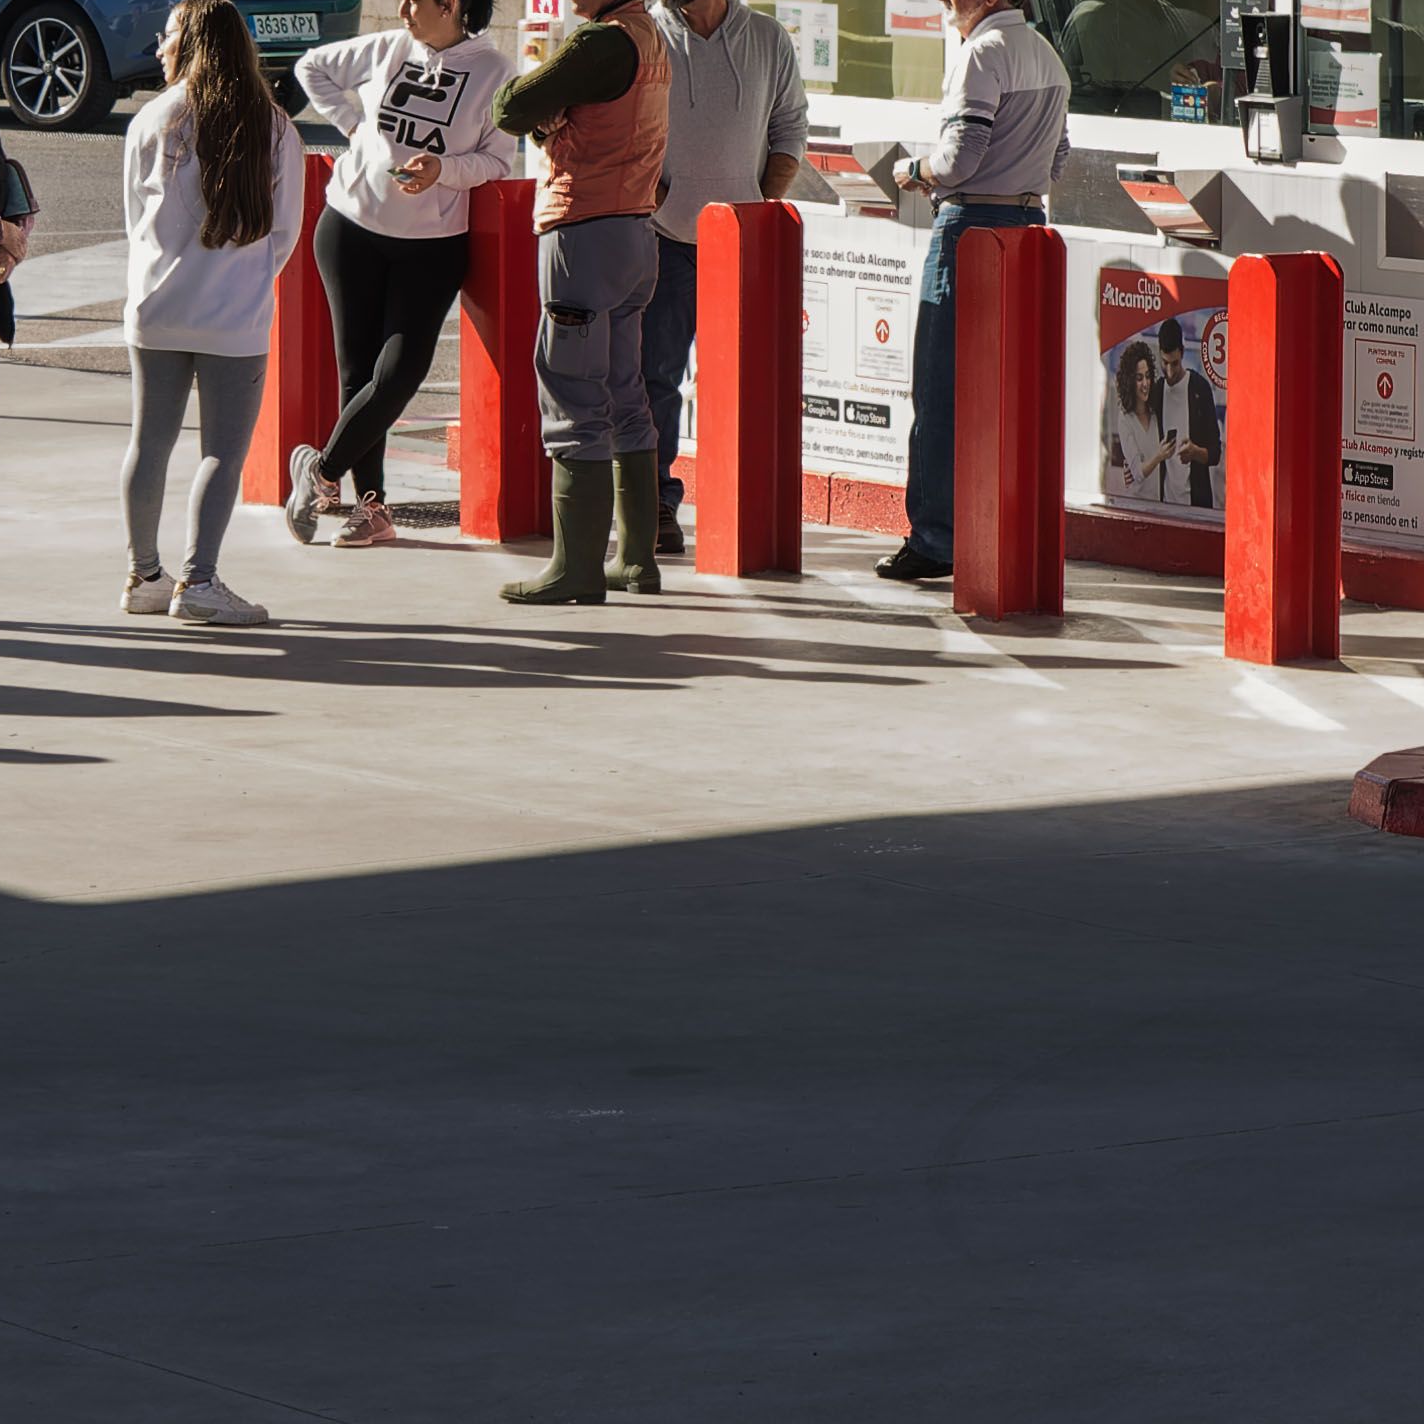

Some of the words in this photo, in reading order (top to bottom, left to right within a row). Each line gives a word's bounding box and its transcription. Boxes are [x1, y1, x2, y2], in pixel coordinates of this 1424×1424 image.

[257, 16, 288, 36] 3636
[290, 14, 316, 34] KPX
[378, 112, 446, 155] FILA
[832, 252, 845, 263] del
[846, 251, 866, 265] Club
[867, 254, 906, 271] Alcampo
[826, 266, 856, 279] ahorrar
[858, 271, 882, 282] como
[883, 274, 912, 286] nunca!
[1137, 278, 1162, 296] Club
[1102, 282, 1162, 314] Alcampo
[1344, 300, 1367, 315] Club
[1368, 303, 1412, 322] Alcampo
[1358, 320, 1384, 335] como
[1385, 323, 1419, 337] nunca!
[1212, 333, 1226, 365] 3
[860, 383, 890, 396] Alcampo
[807, 404, 825, 417] Google
[856, 411, 869, 424] App
[869, 413, 886, 425] Store
[1341, 438, 1358, 450] Club
[1359, 441, 1393, 457] Alcampo
[1393, 447, 1400, 458] y
[1354, 472, 1370, 486] App
[1370, 473, 1389, 486] Store
[1367, 495, 1376, 504] en
[1377, 494, 1400, 508] tienda
[1354, 511, 1397, 527] pensando
[1398, 518, 1409, 527] en
[1411, 516, 1418, 529] ti
